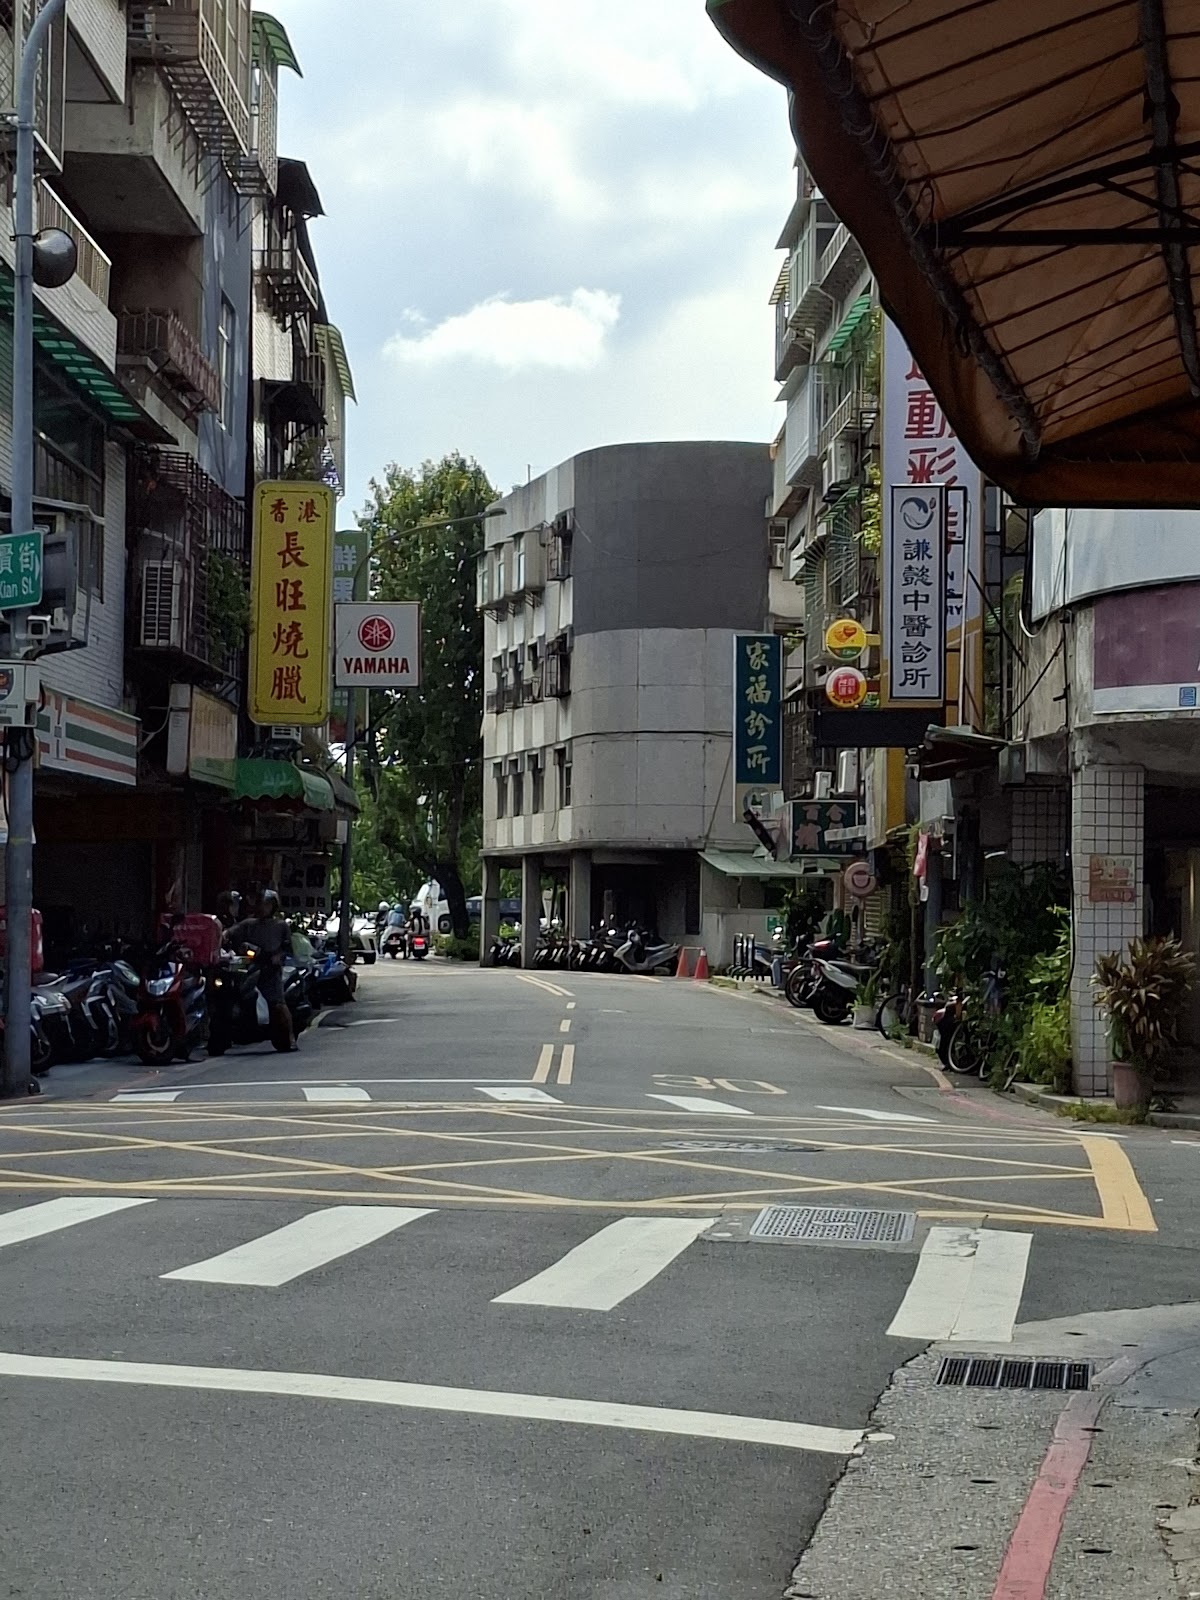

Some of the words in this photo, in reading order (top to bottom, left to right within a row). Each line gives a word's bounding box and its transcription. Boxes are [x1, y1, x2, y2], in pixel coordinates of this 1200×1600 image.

[270, 498, 321, 523] 香港
[343, 657, 410, 674] YAMAHA
[744, 640, 774, 775] 家福診所
